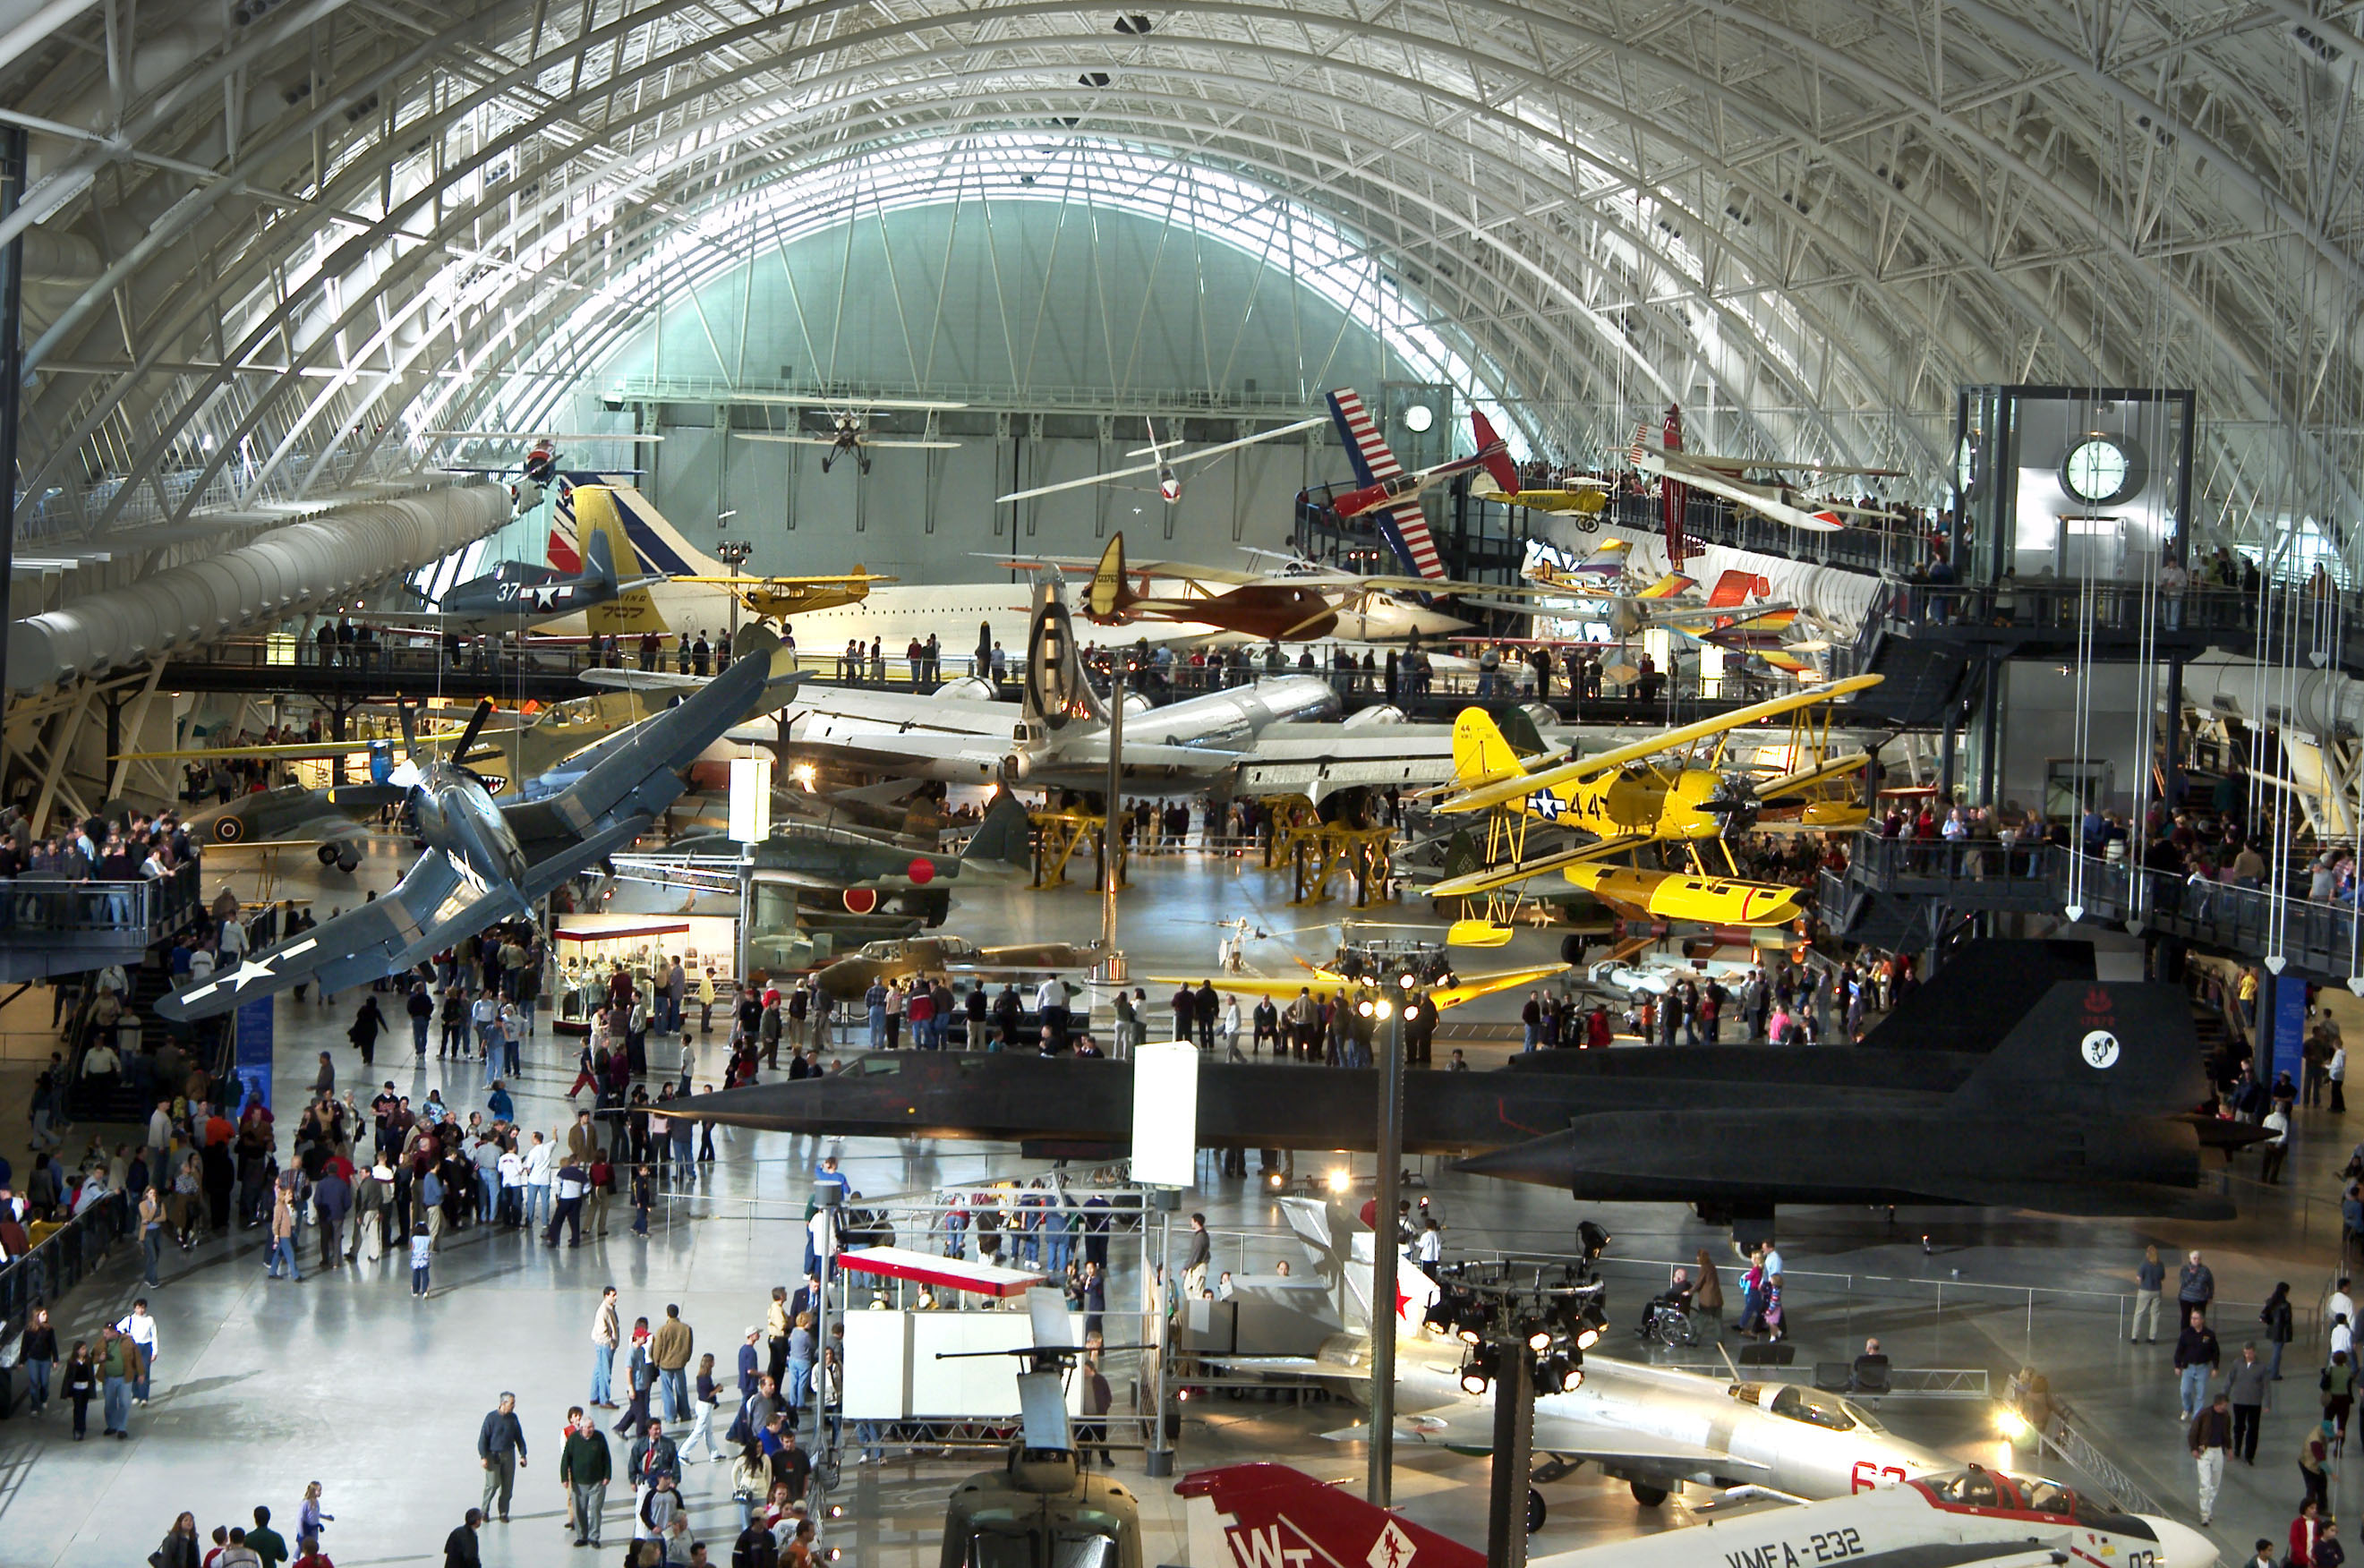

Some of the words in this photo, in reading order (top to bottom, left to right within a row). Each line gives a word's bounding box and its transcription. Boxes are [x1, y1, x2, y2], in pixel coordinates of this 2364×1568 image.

[496, 582, 521, 601] 37
[602, 606, 645, 619] 707
[1570, 792, 1600, 821] 44
[1725, 1527, 1865, 1568] VMFA-232
